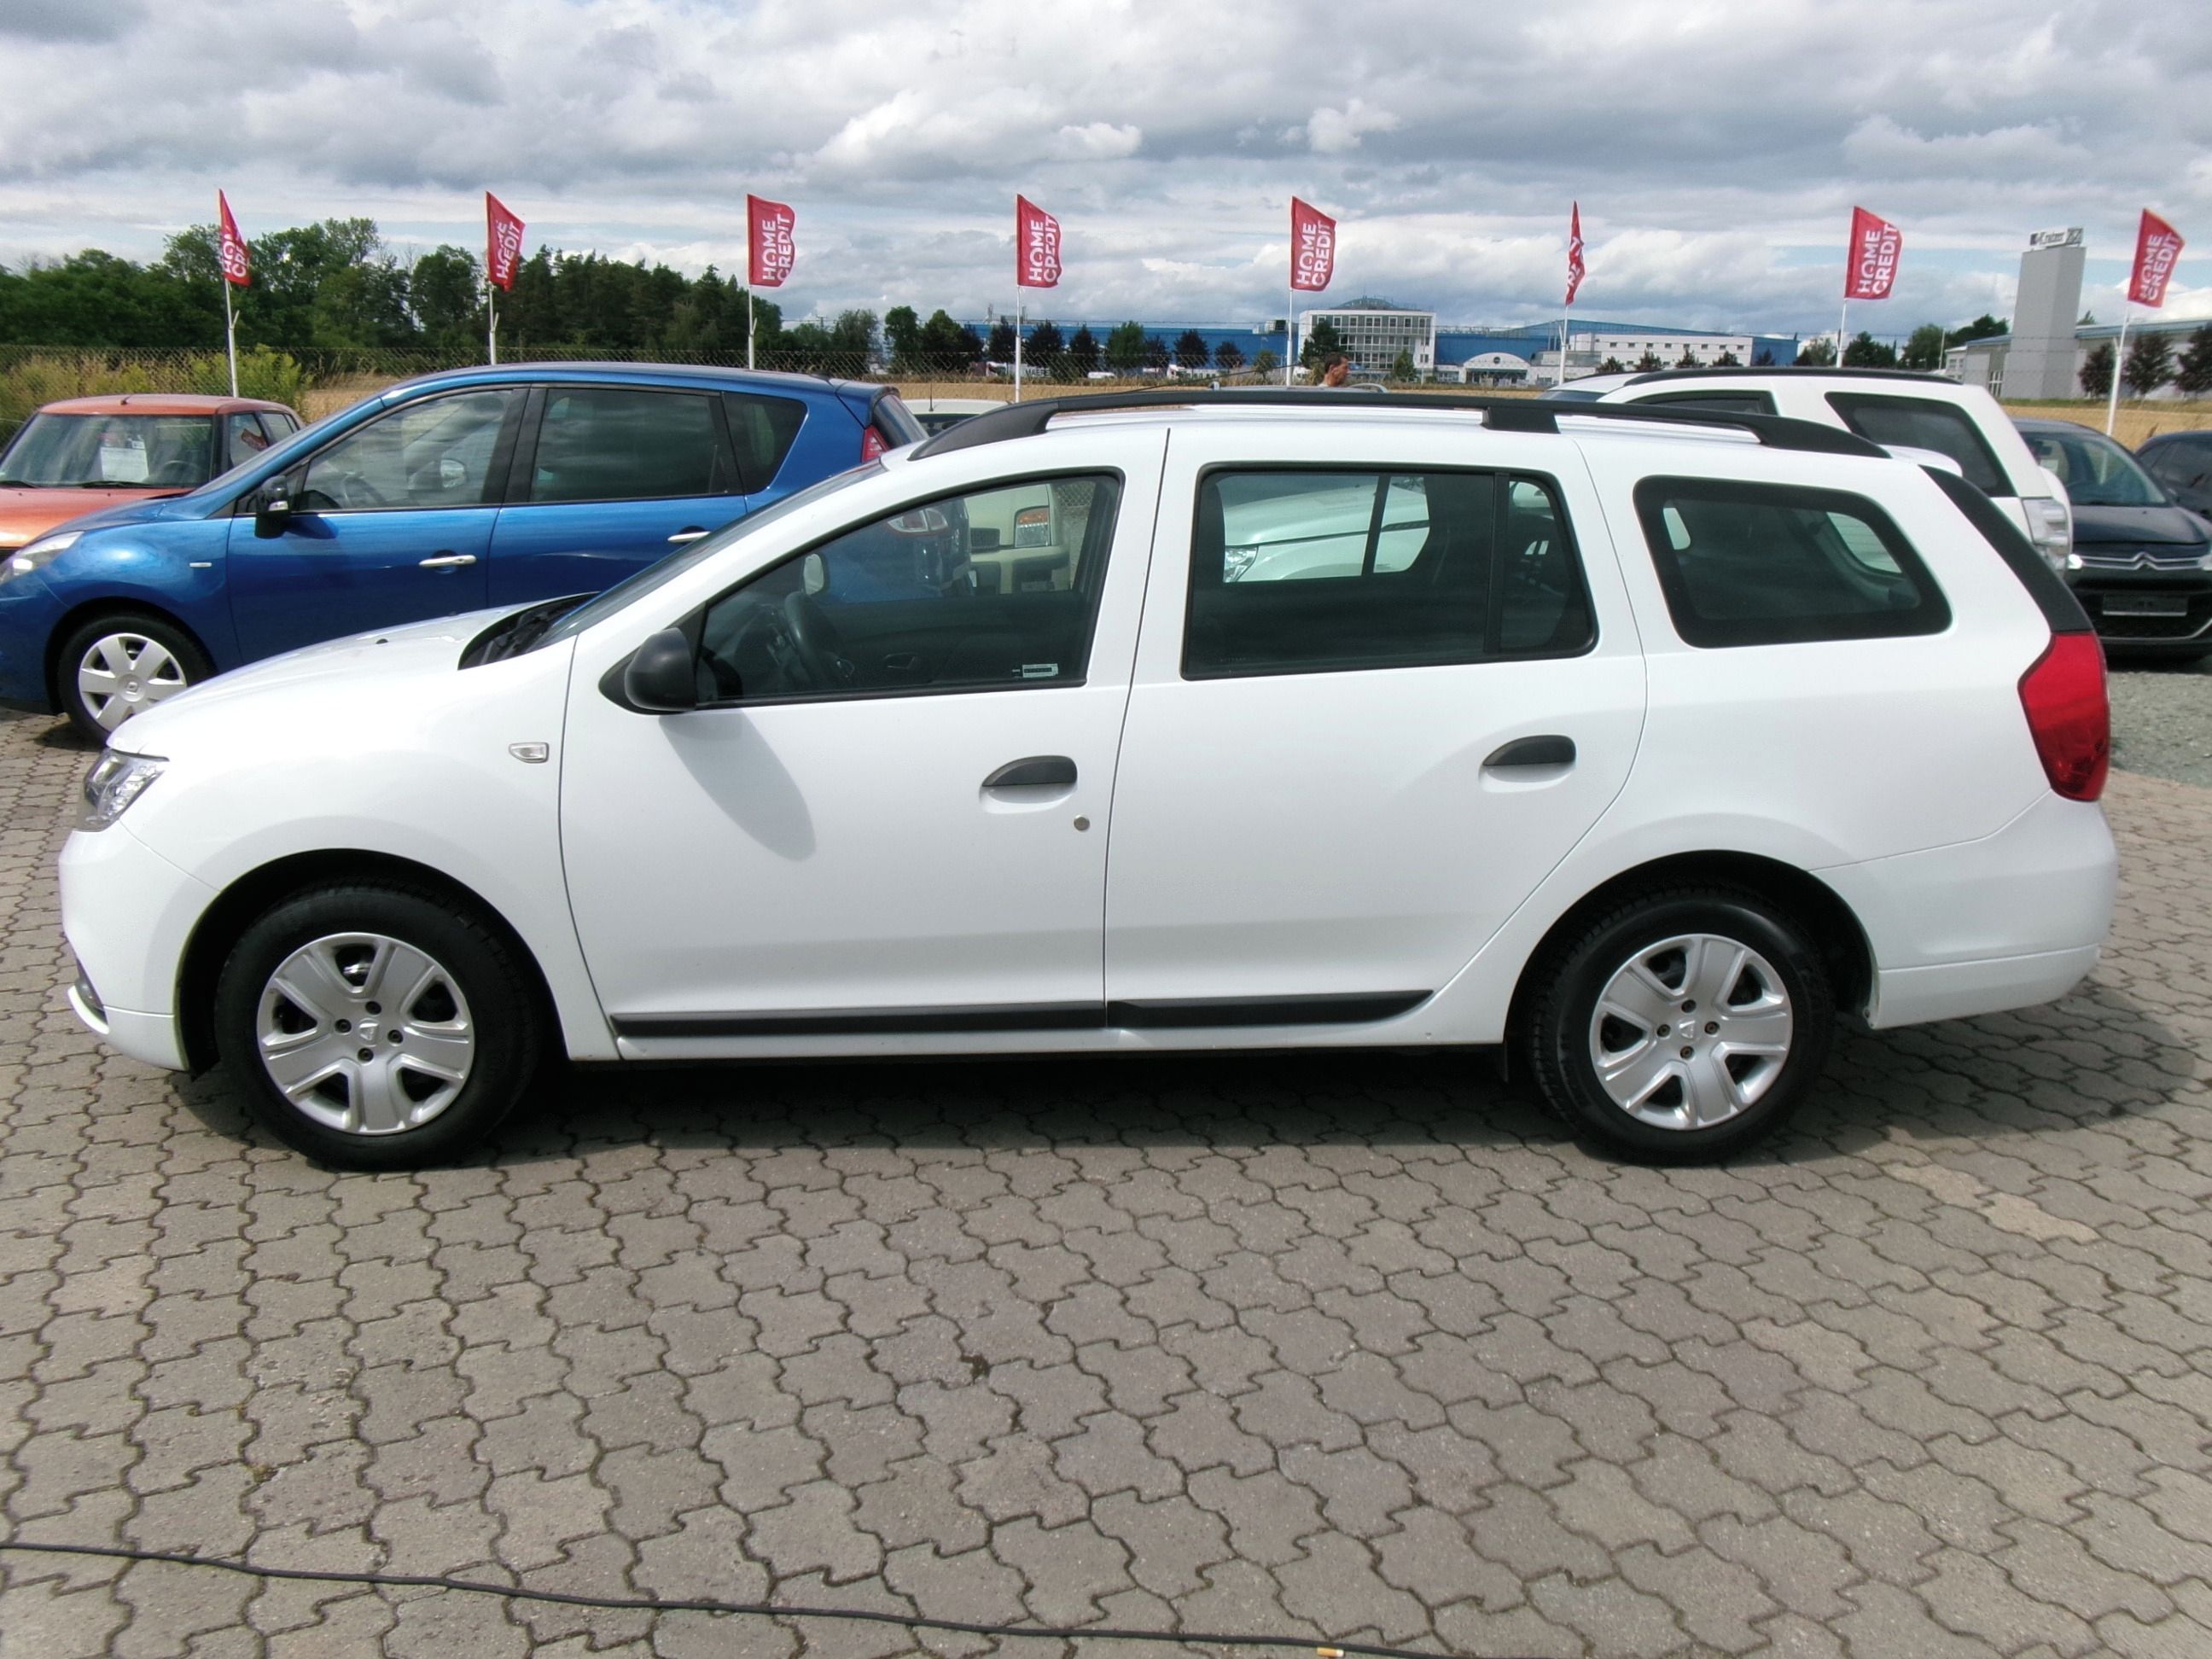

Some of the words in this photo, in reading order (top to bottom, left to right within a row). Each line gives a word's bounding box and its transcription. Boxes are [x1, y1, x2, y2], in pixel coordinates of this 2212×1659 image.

[762, 219, 777, 281] HOME
[777, 213, 792, 282] CREDIT
[1028, 219, 1044, 282] HOME
[1296, 223, 1317, 285] HOME
[1312, 219, 1331, 287] CREDIT
[1857, 230, 1881, 294] HOME
[1872, 224, 1897, 295] CREDIT
[2139, 234, 2163, 299] HOME
[2147, 231, 2179, 300] CREDIT
